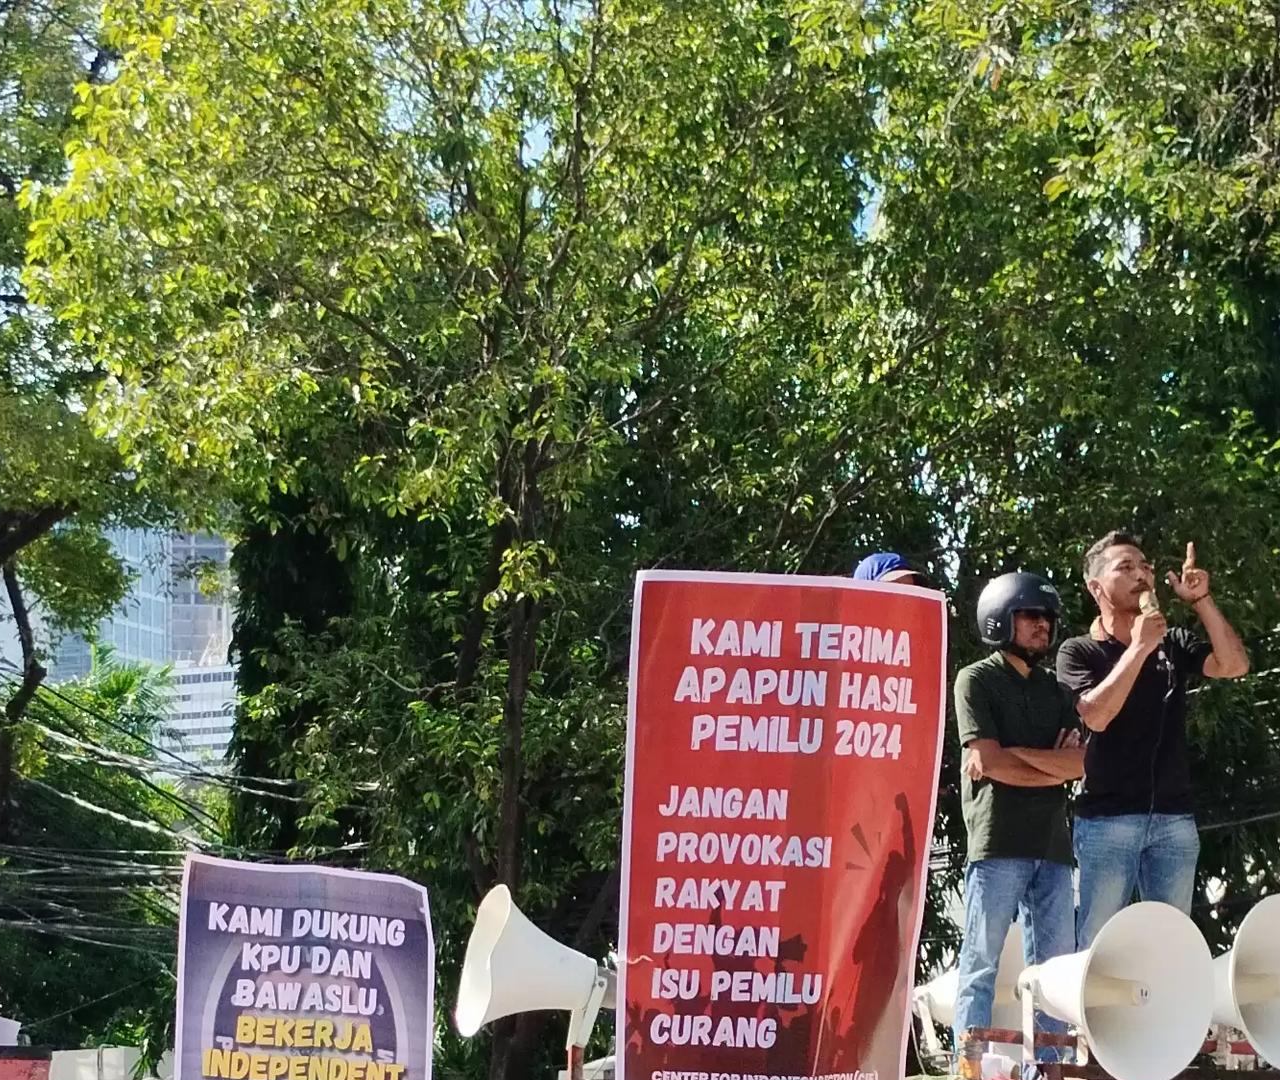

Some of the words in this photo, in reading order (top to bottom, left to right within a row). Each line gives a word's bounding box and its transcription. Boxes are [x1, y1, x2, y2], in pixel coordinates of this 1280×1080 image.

[690, 618, 783, 658] KAMI
[795, 622, 911, 667] TERIMA
[674, 667, 827, 706] APAPUN
[839, 672, 918, 713] HASIL
[690, 715, 823, 753] PEMILU
[834, 720, 902, 759] 2024
[659, 785, 787, 820] JANGAN
[656, 832, 832, 868] PROVOKASI
[655, 878, 786, 912] RAKYAT
[208, 902, 283, 937] KAMI
[292, 909, 405, 947] DUKUNG
[653, 922, 780, 957] DENGAN
[241, 942, 301, 973] KPU
[312, 947, 372, 979] DAN
[232, 979, 377, 1016] BAWASLU
[651, 967, 701, 999] ISU
[710, 971, 823, 1005] PEMILU
[236, 1017, 373, 1052] BEKERJA
[651, 1014, 777, 1048] CURANG
